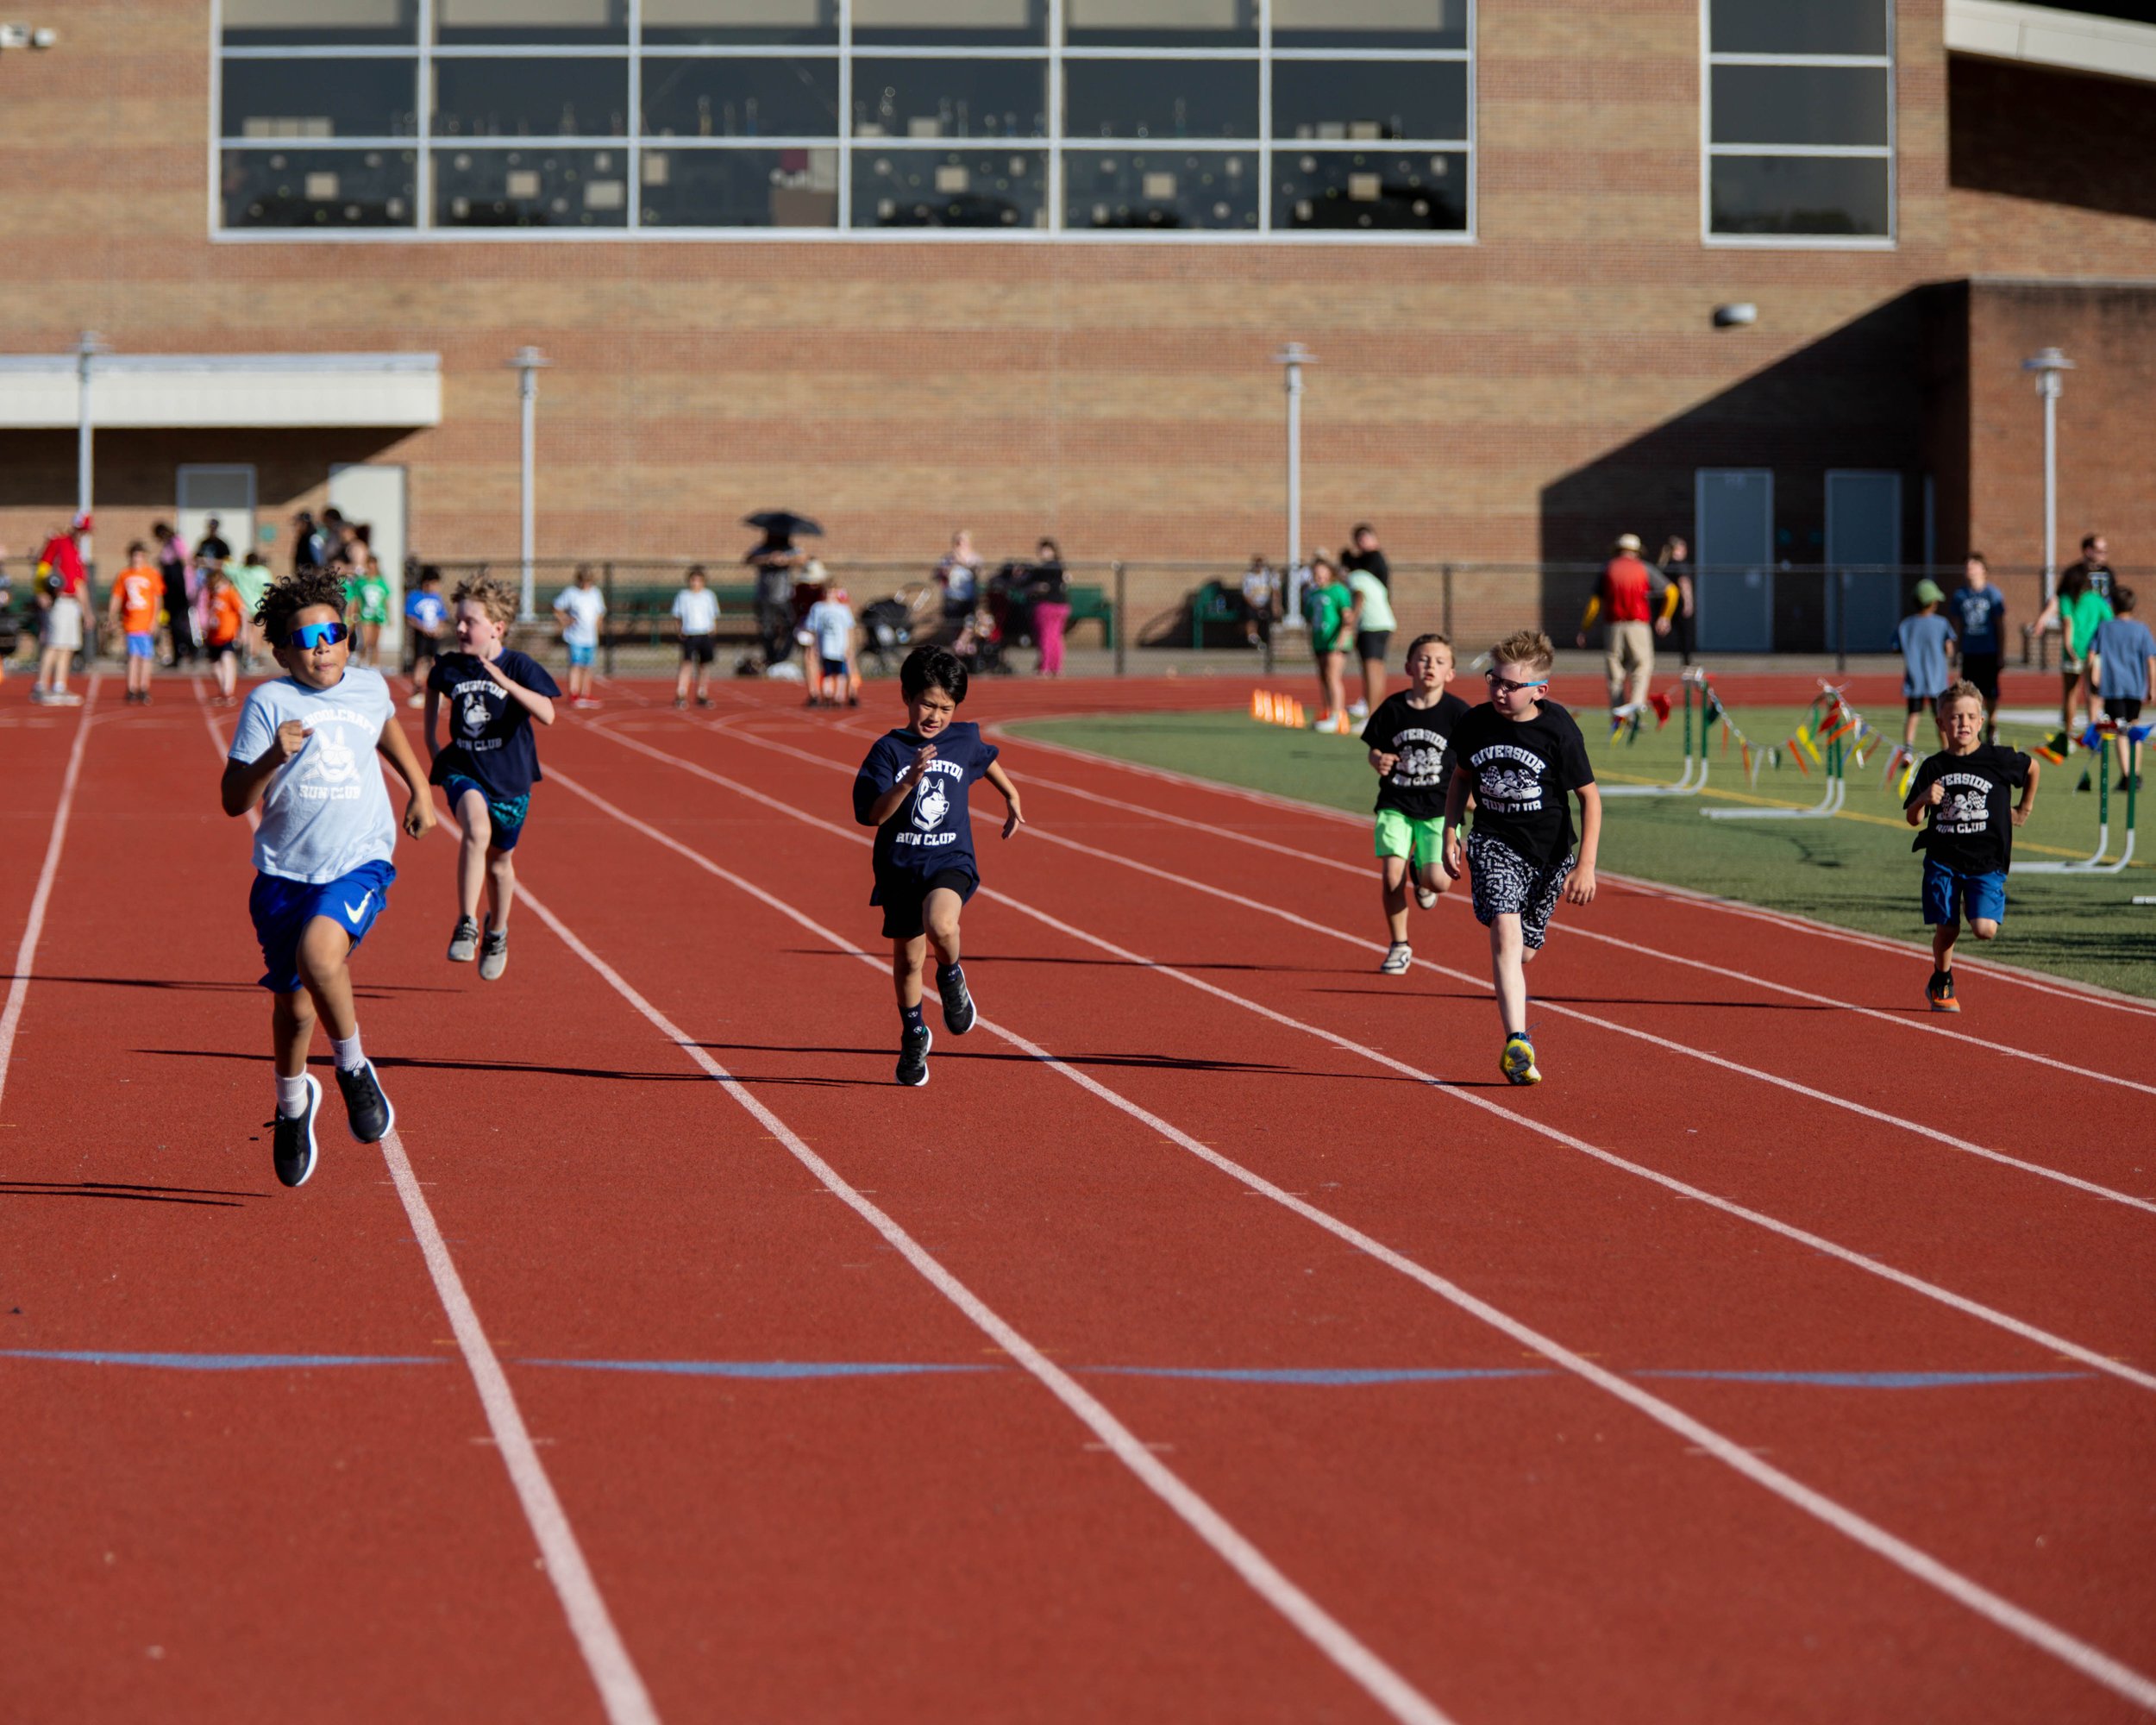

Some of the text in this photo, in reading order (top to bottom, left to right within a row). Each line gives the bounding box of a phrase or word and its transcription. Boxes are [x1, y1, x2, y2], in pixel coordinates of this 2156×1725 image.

[474, 737, 503, 751] CLUB
[1470, 744, 1546, 775] RIVERSIDE
[299, 784, 360, 800] RUN CLUB
[1957, 820, 1987, 834] CLUB
[895, 832, 922, 845] RUN
